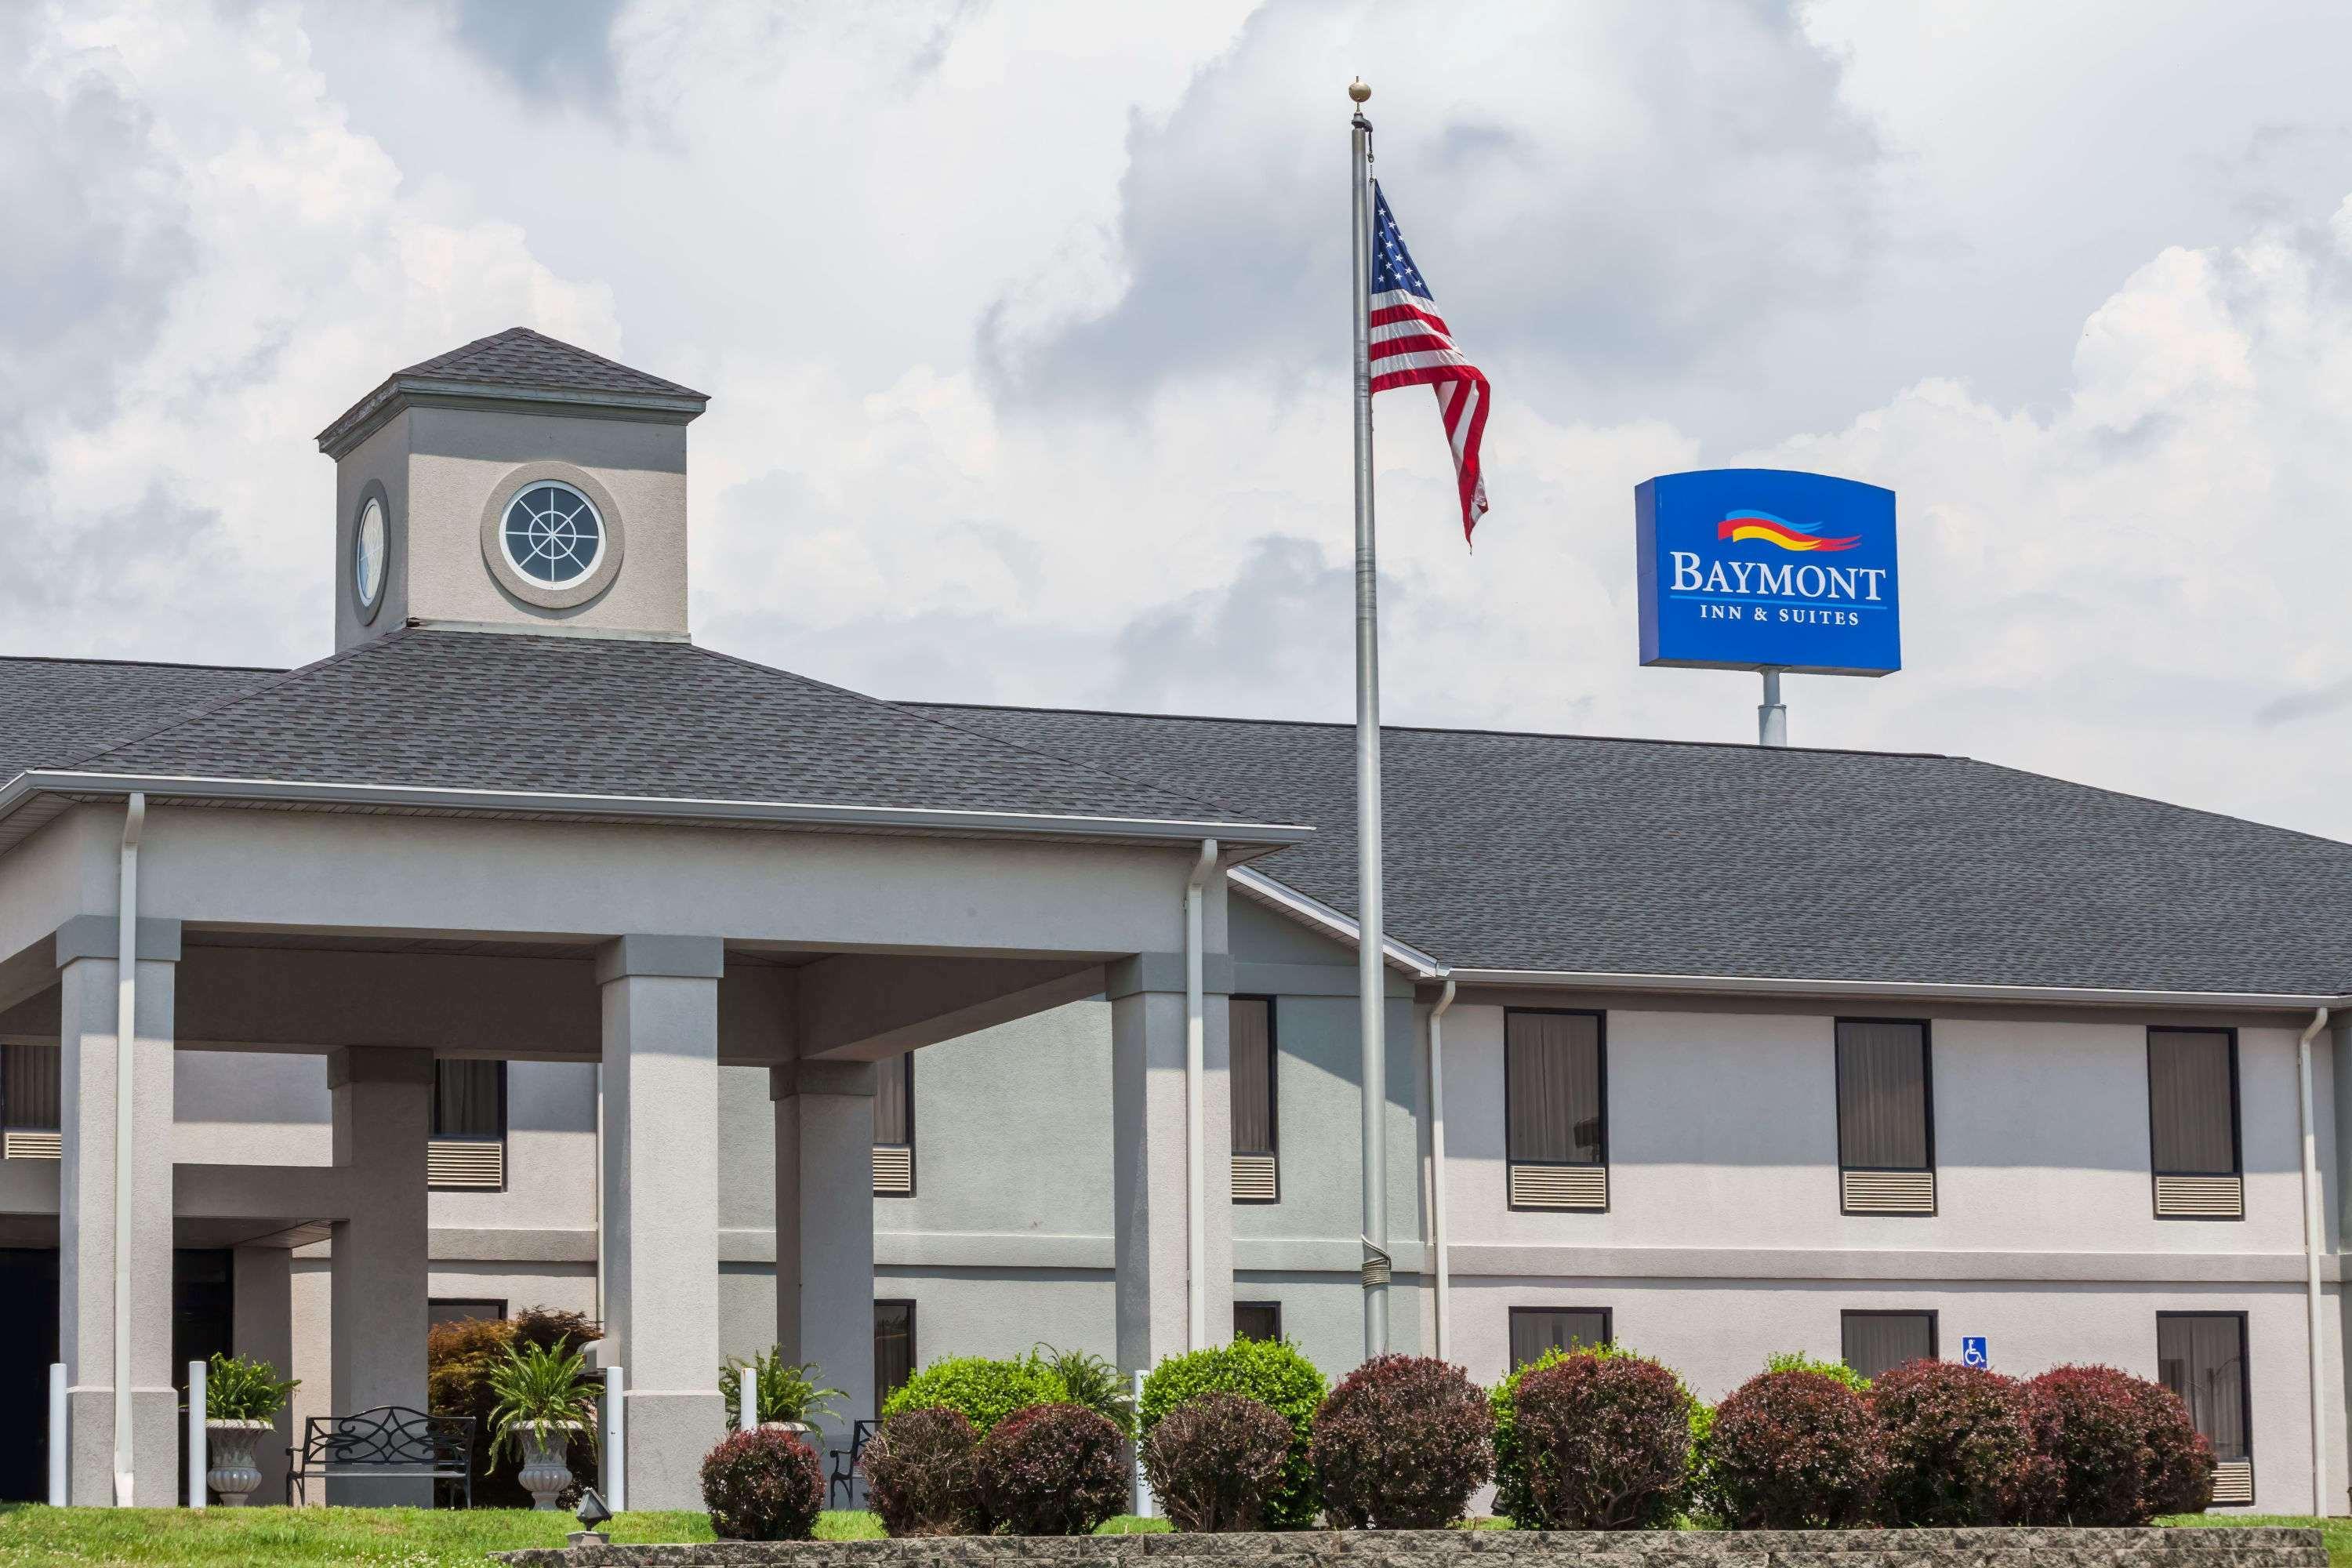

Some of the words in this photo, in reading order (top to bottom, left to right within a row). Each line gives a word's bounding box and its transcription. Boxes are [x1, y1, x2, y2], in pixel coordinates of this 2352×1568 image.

[1669, 551, 1886, 601] BAYMONT
[1700, 604, 1742, 620] INN
[1754, 607, 1768, 622] &
[1779, 608, 1859, 626] SUITES
